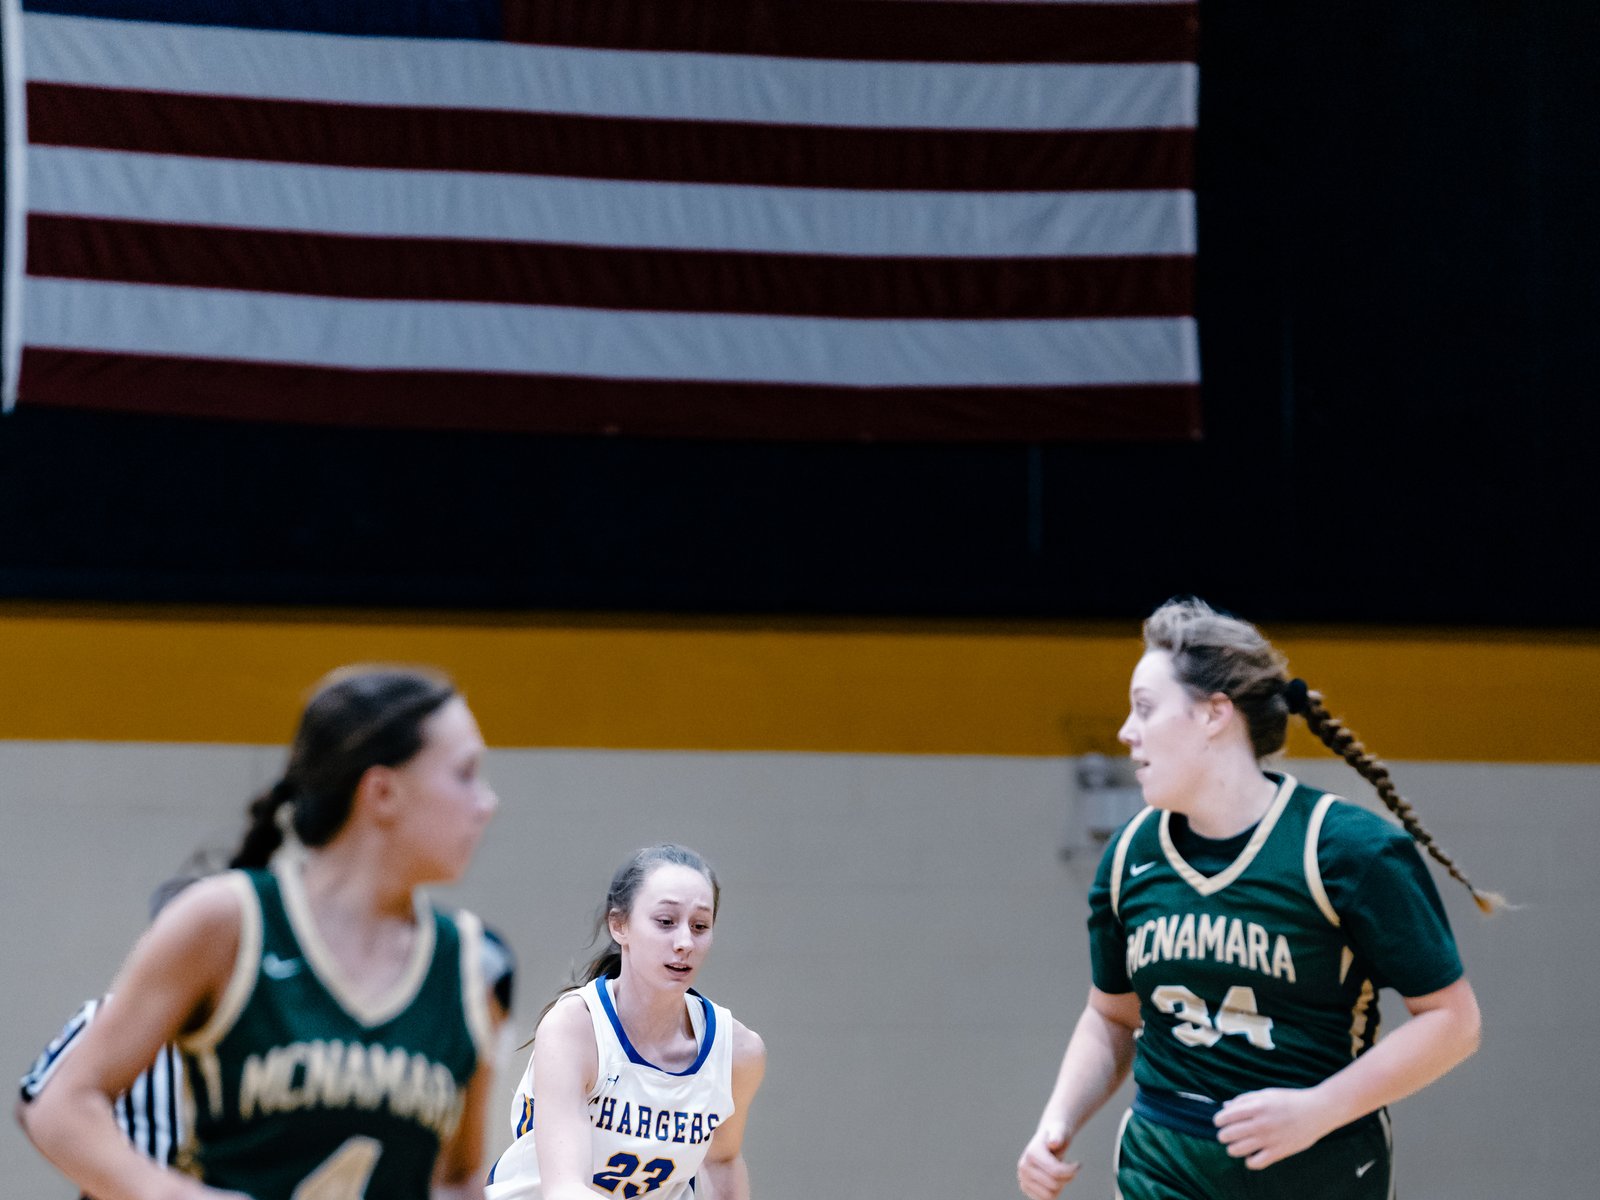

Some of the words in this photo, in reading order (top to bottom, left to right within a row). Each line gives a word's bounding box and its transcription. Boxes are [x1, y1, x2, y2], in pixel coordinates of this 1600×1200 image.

[1127, 914, 1296, 984] MCNAMARA
[1151, 984, 1276, 1051] 34
[592, 1151, 677, 1200] 23
